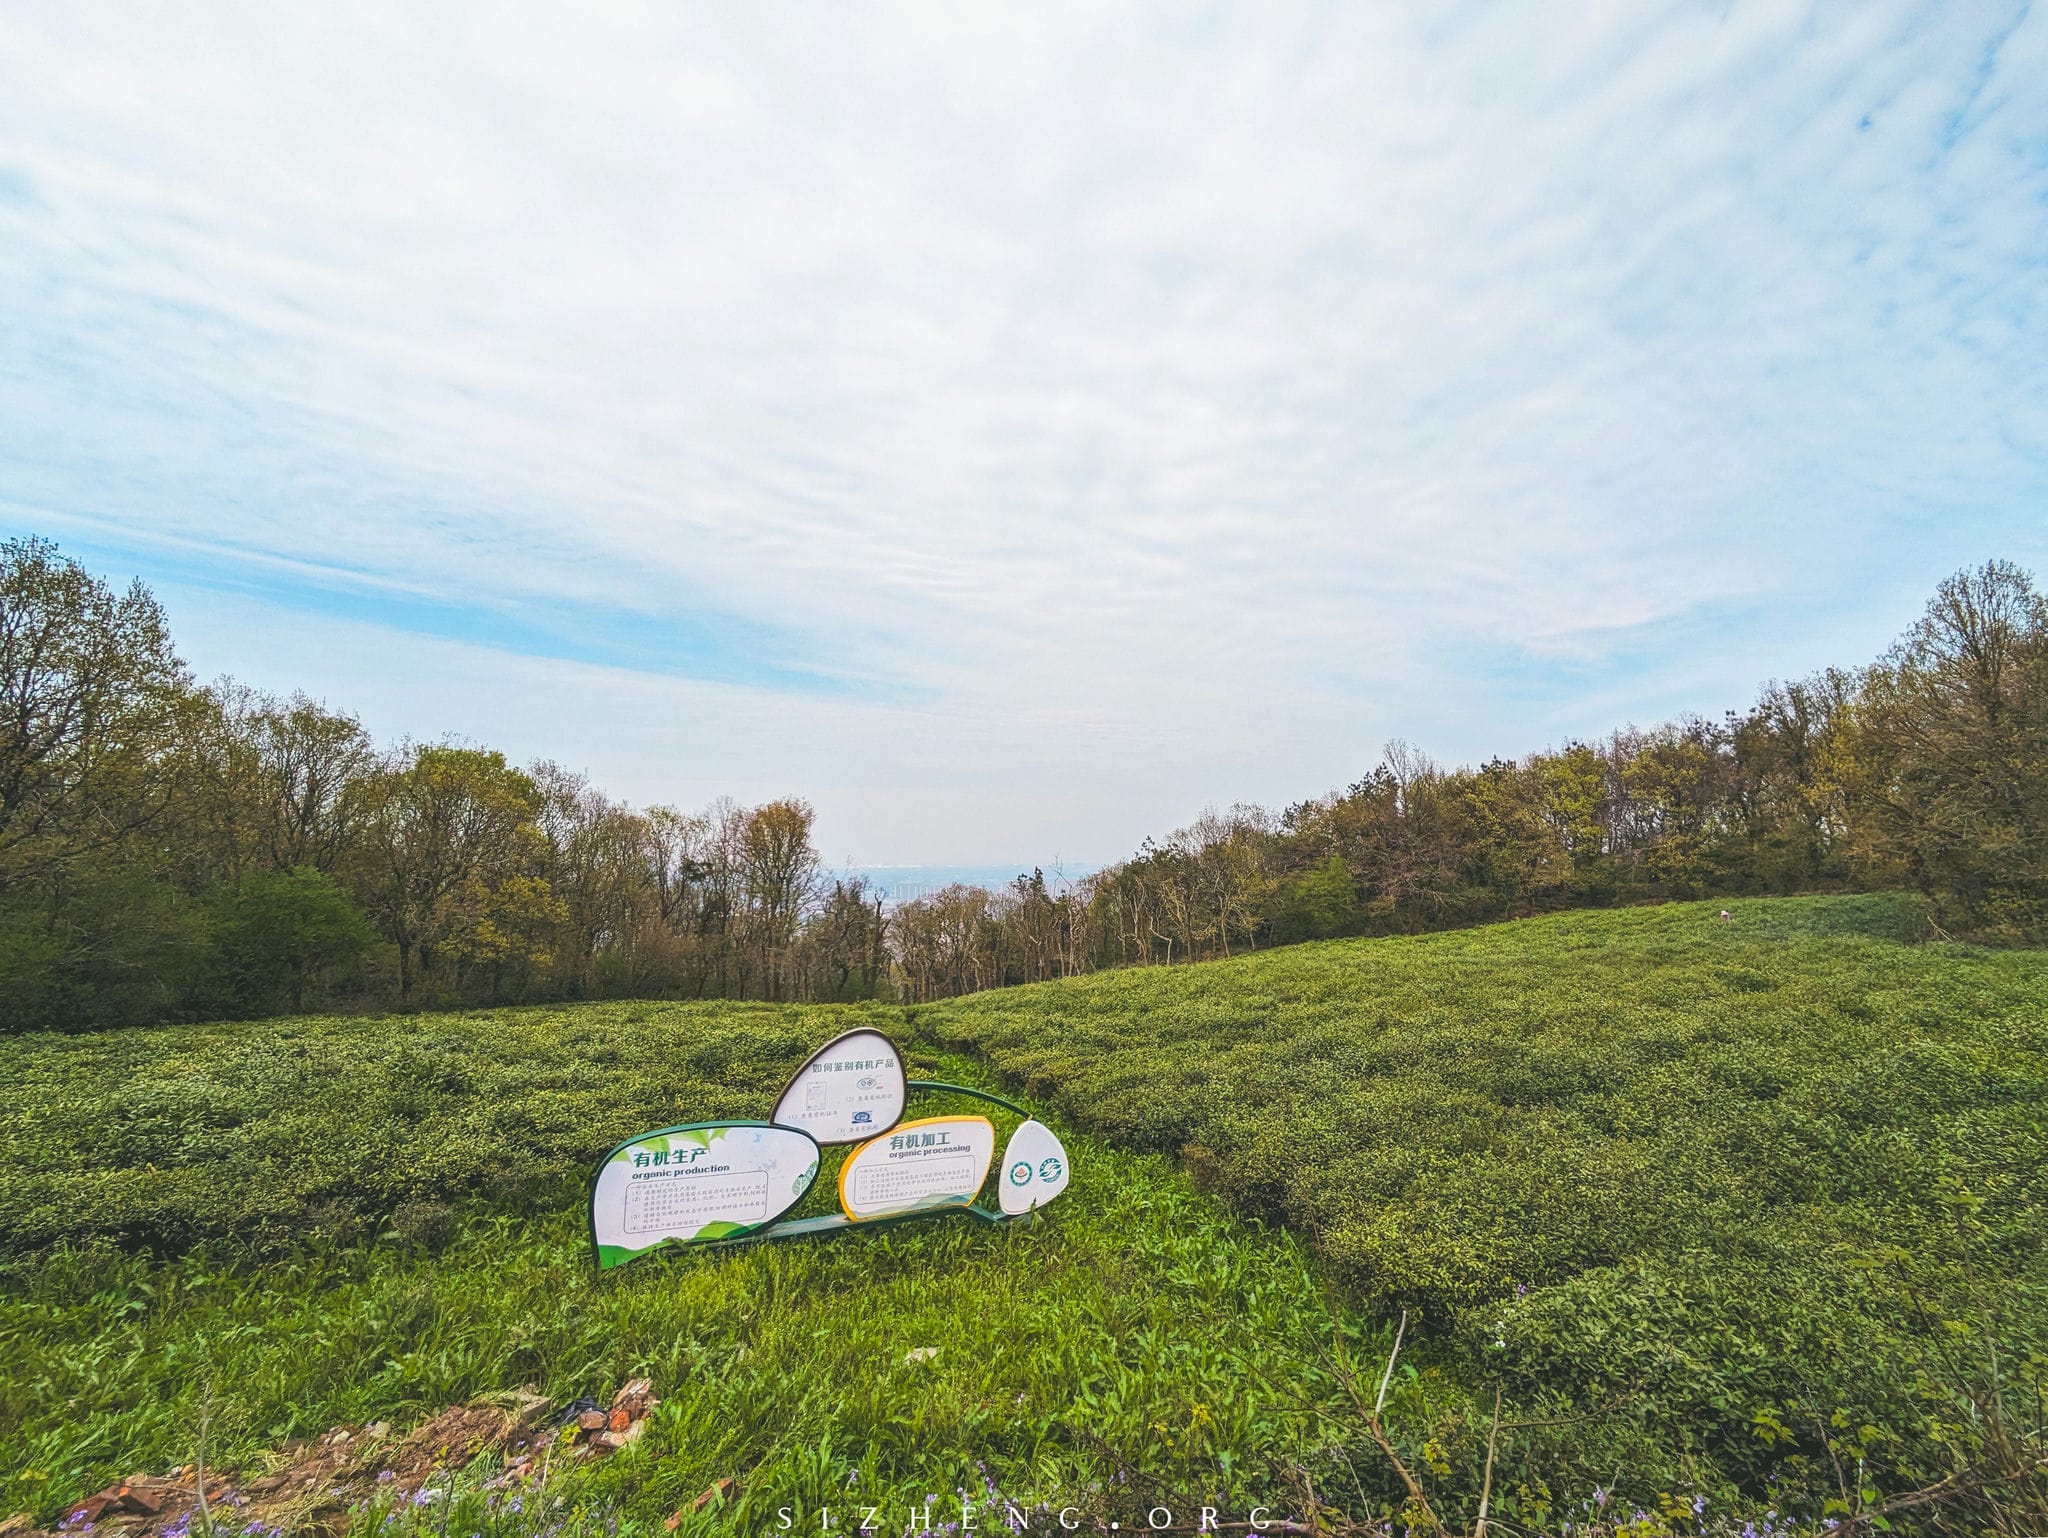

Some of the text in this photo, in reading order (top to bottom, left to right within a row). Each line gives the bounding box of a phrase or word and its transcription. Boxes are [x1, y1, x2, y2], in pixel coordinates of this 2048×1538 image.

[812, 1059, 894, 1072] 如何鉴别有机产品
[889, 1131, 951, 1151] 有机加工
[633, 1148, 708, 1167] 有机生产
[889, 1143, 971, 1160] organic processing
[632, 1164, 730, 1181] organic production
